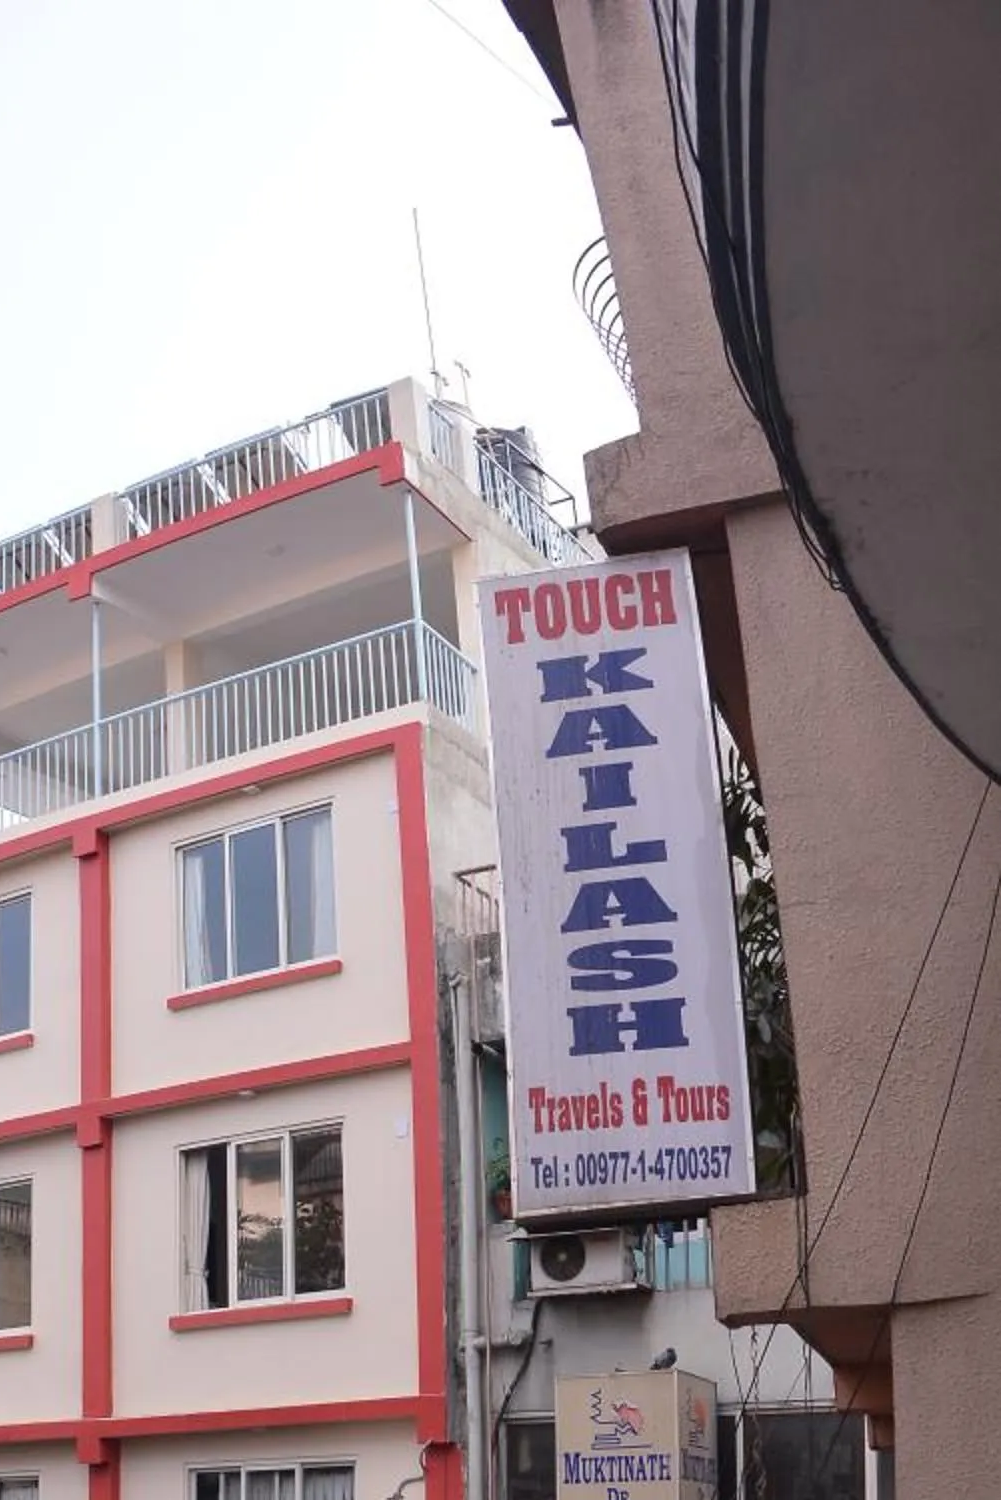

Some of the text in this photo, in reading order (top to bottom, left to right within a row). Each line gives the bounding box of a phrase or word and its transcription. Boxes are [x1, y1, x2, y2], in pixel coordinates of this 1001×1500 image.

[495, 569, 677, 645] TOUCH
[535, 646, 690, 1057] KAILASH
[528, 1075, 731, 1134] Travels & Tours
[576, 1145, 732, 1187] 00977-1-4700357
[563, 1452, 672, 1485] MUKTINATH
